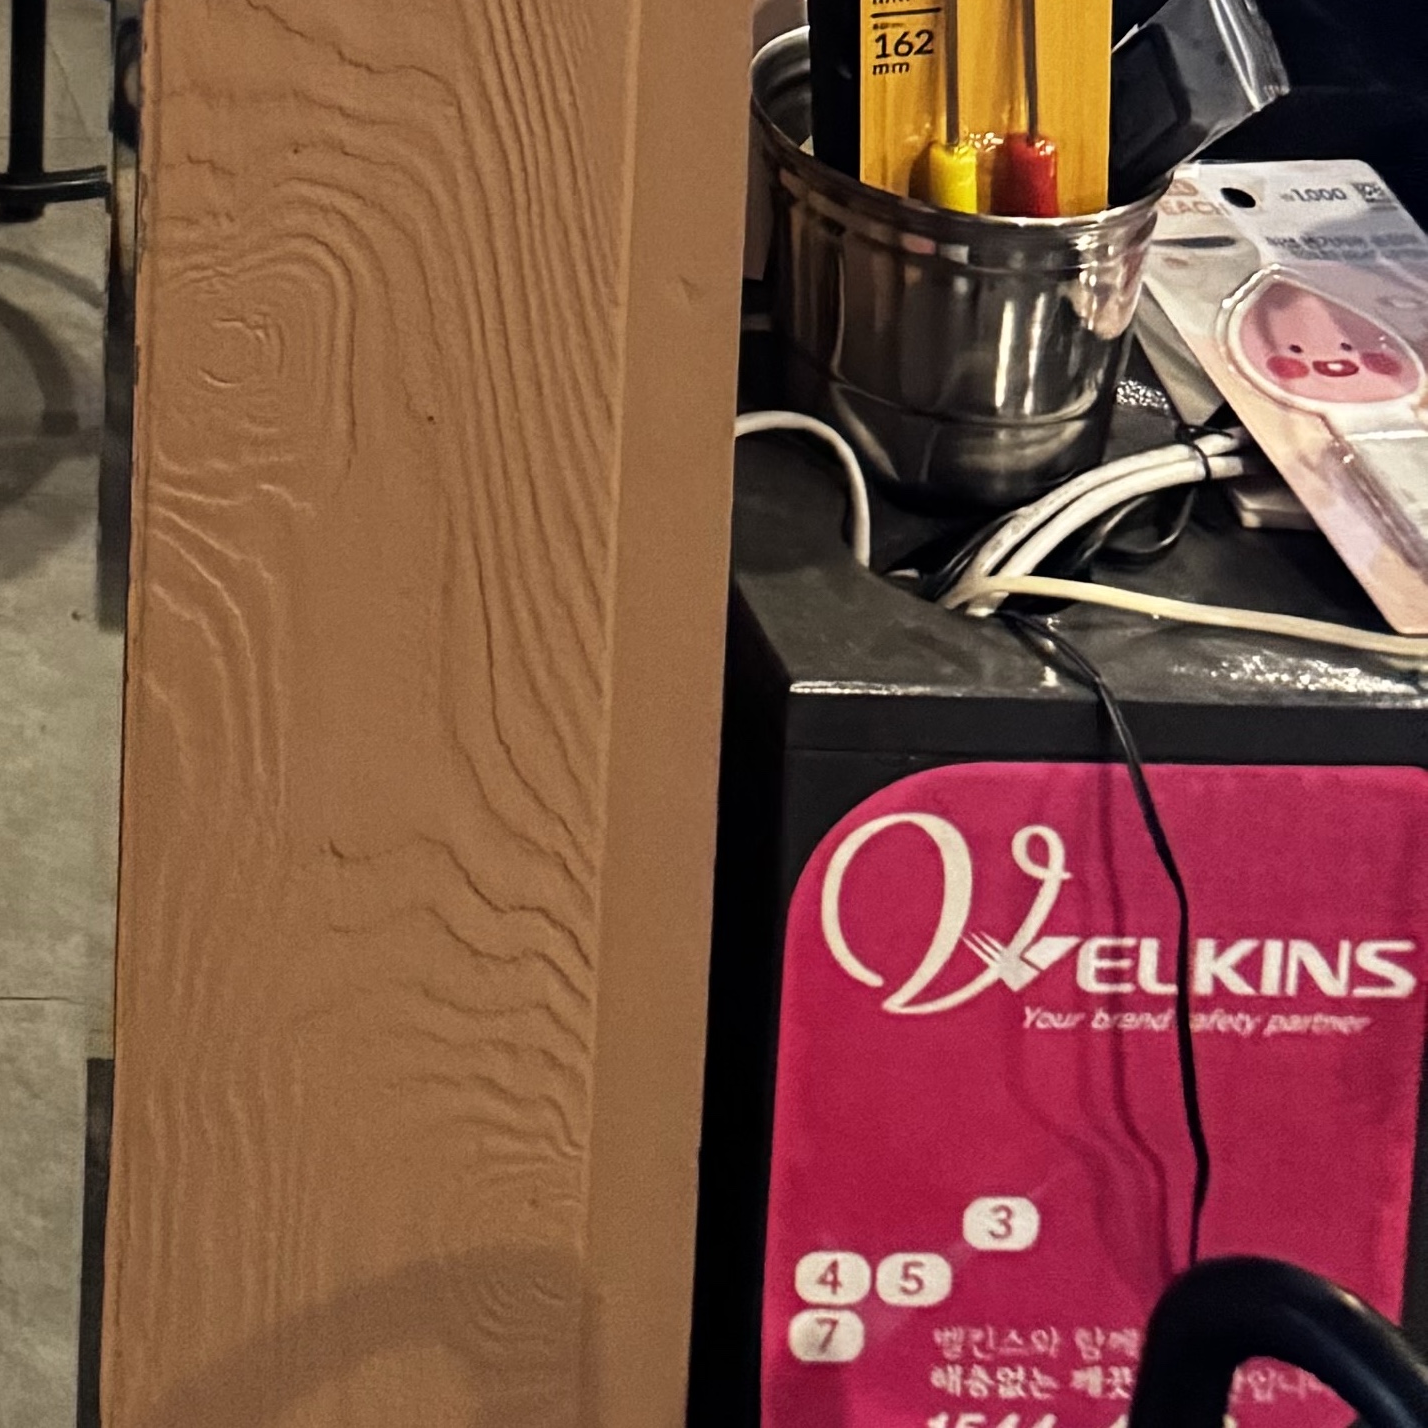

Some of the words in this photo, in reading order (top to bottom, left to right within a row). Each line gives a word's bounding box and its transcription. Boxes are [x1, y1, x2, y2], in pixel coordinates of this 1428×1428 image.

[874, 29, 934, 59] 162
[872, 62, 910, 75] mm
[1023, 1006, 1085, 1029] Your
[1091, 1007, 1177, 1032] brand
[1183, 1009, 1258, 1037] afety
[988, 1205, 1013, 1240] 3
[817, 1259, 842, 1295] 4
[900, 1261, 925, 1296] 5
[816, 1317, 839, 1354] 7
